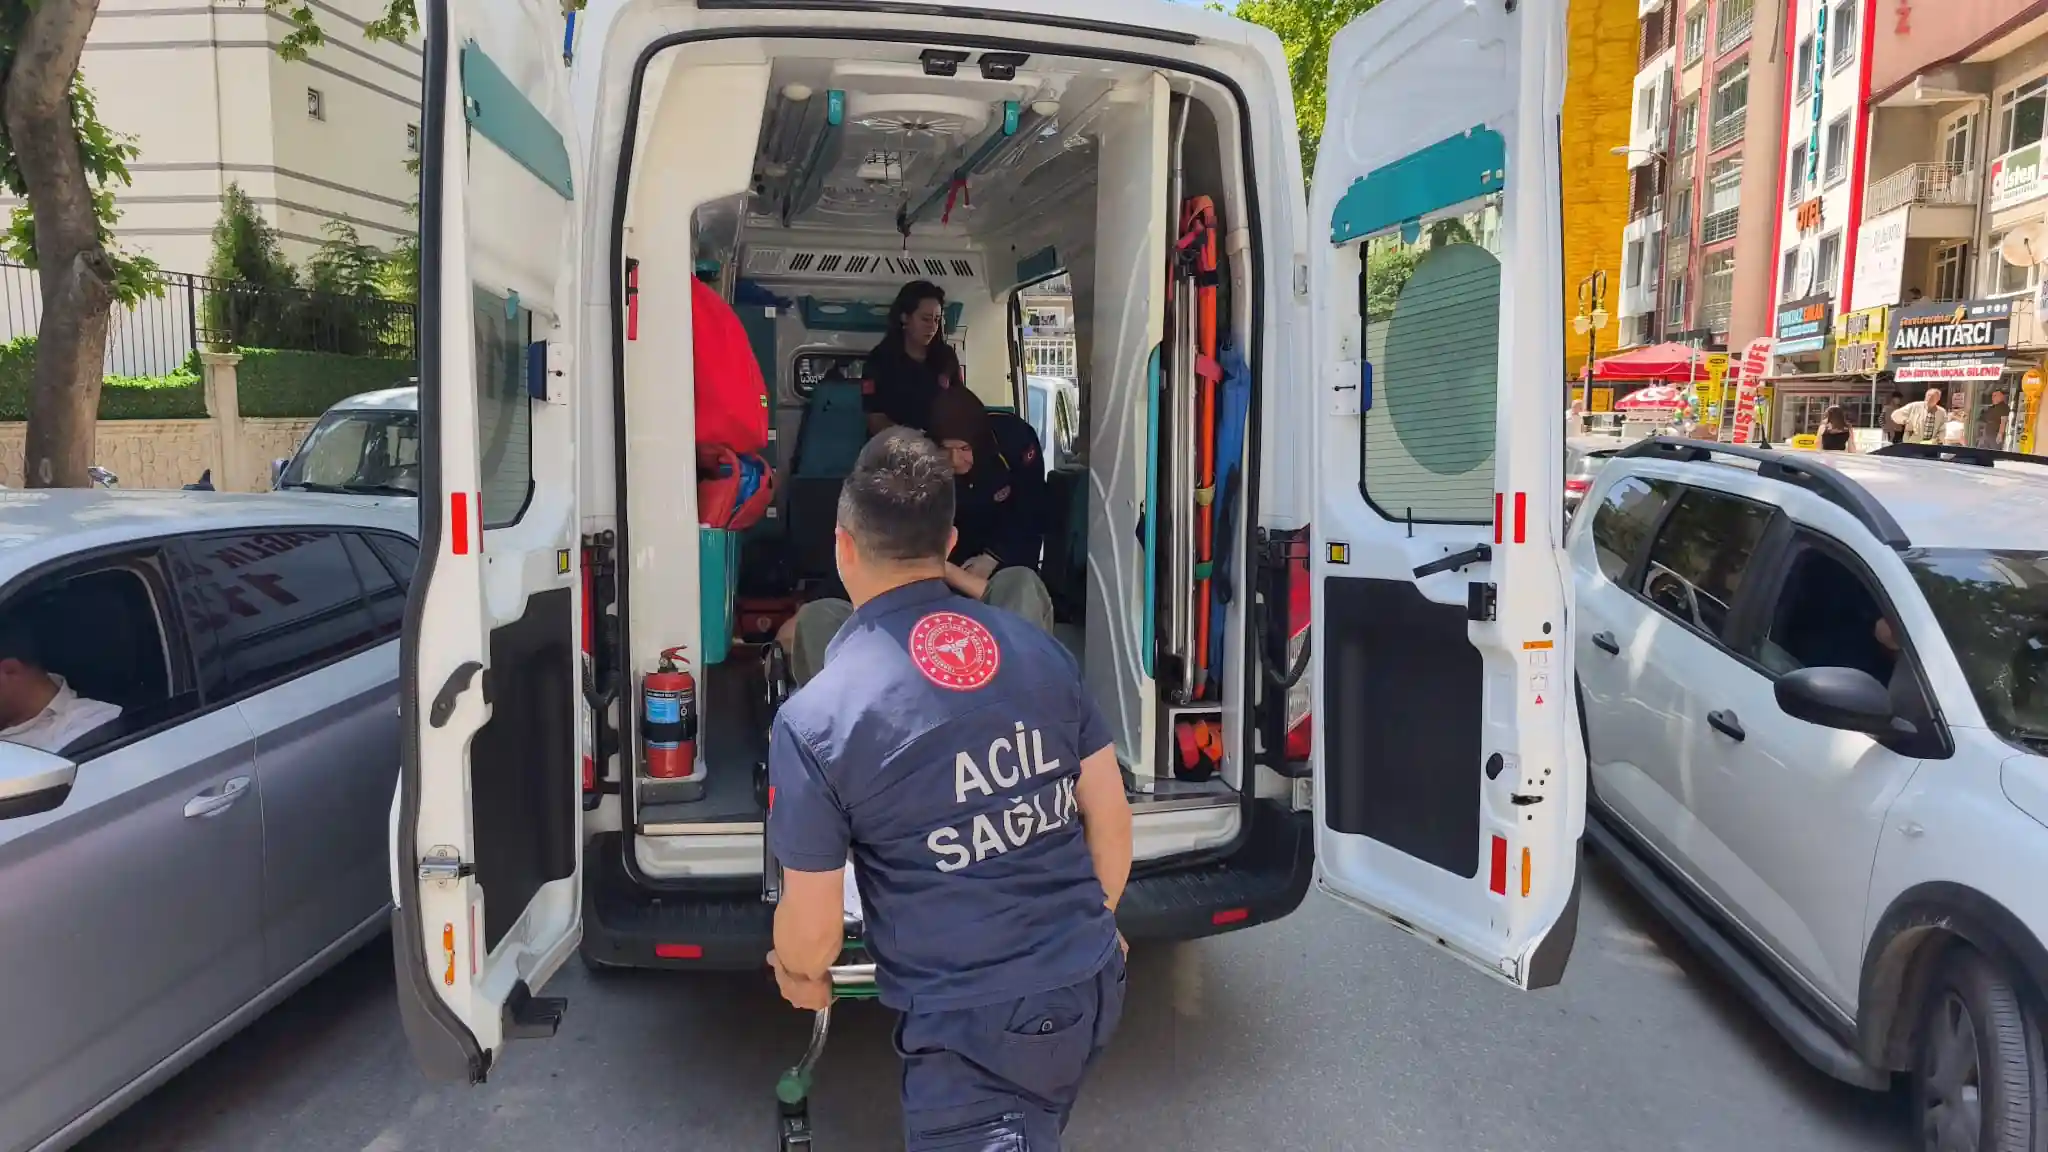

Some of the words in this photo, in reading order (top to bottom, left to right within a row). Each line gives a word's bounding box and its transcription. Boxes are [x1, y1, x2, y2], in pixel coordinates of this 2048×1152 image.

[1796, 196, 1821, 232] OTEL
[1894, 322, 1992, 349] ANAHTARCI
[955, 720, 1060, 803] ACİL
[927, 775, 1078, 873] SAĞLIK
